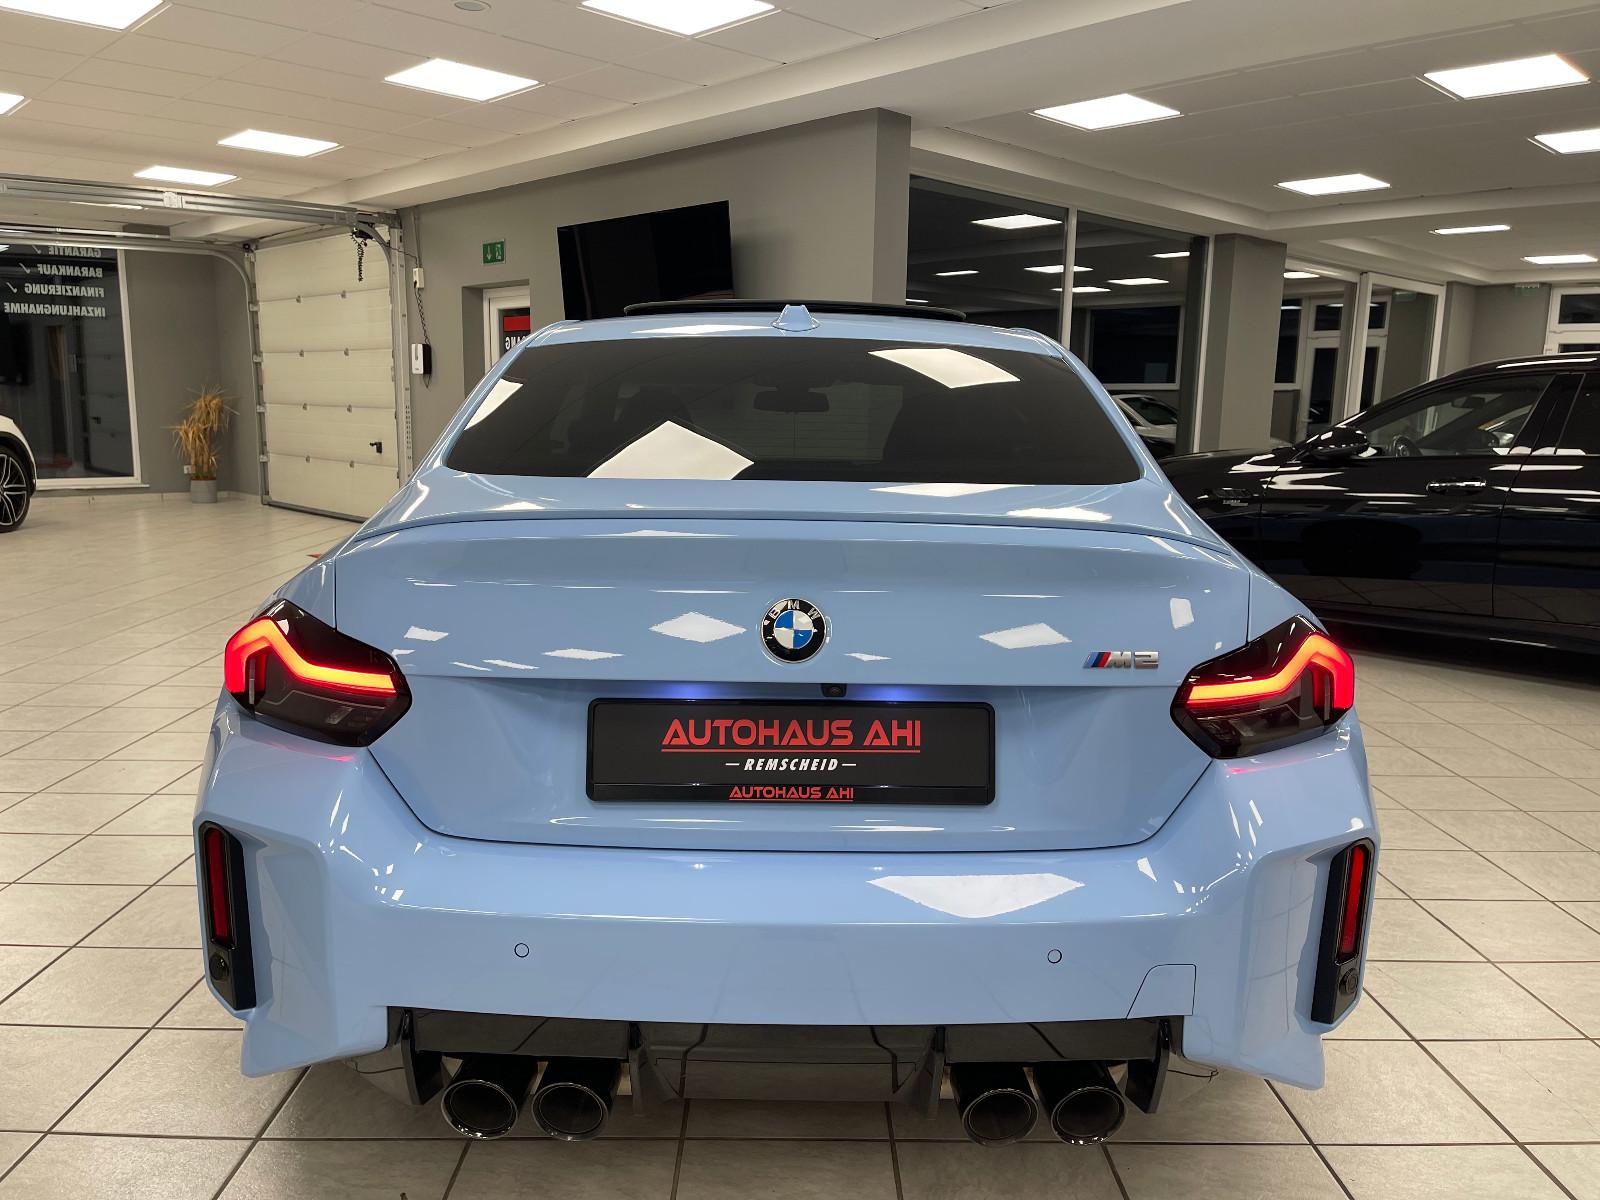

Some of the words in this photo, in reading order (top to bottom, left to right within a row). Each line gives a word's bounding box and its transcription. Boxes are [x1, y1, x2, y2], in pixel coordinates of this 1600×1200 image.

[1102, 651, 1159, 669] M2
[661, 719, 854, 746] AUTOHAUS
[863, 719, 921, 746] AHI
[743, 758, 839, 771] REMSCHEID
[729, 786, 822, 799] AUTOHAUS
[825, 787, 854, 799] AHI
